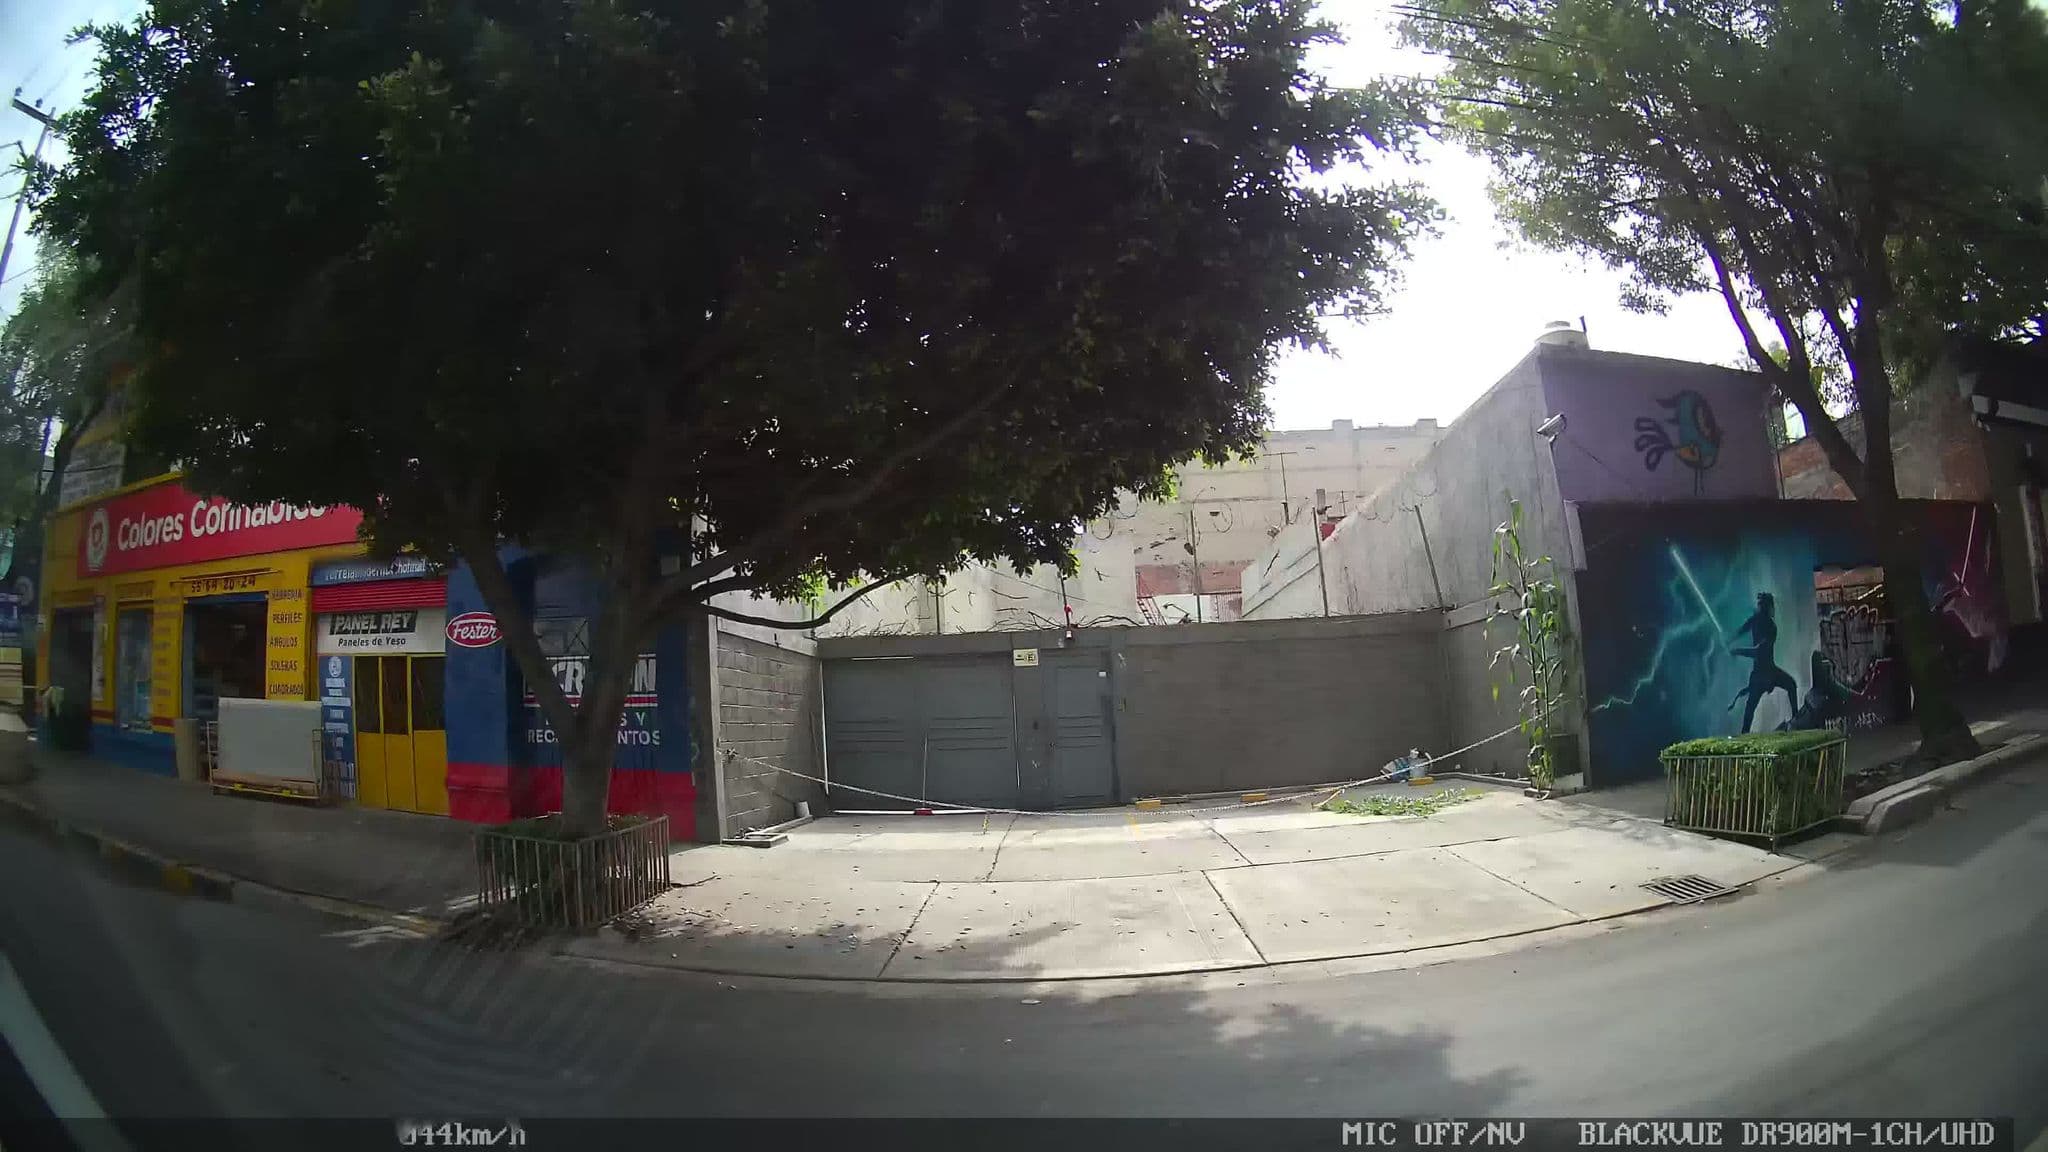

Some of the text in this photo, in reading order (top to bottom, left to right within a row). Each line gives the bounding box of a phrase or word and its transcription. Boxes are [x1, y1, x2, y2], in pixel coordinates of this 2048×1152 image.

[117, 511, 184, 551] Colores
[272, 612, 303, 624] PERFILES
[334, 611, 413, 631] PANEL REY
[452, 618, 498, 640] Fester
[269, 635, 298, 648] ANGULOS
[338, 636, 406, 647] Paneles de Yeso
[270, 659, 298, 671] SOLERAS
